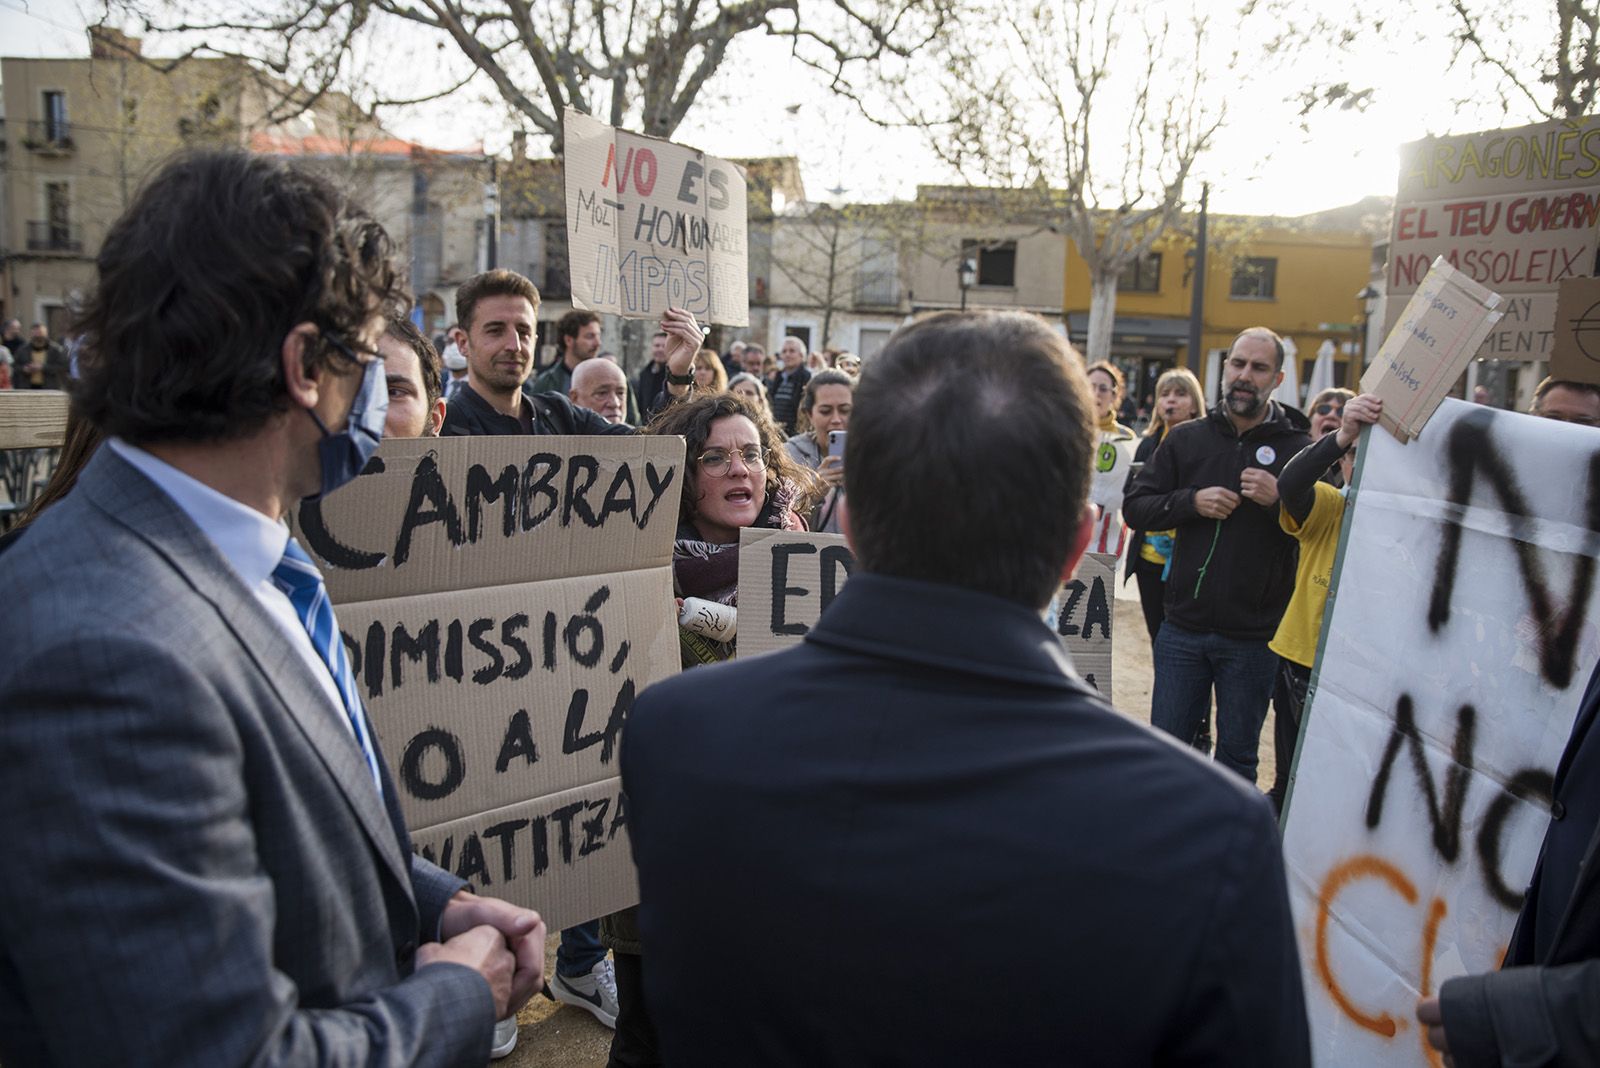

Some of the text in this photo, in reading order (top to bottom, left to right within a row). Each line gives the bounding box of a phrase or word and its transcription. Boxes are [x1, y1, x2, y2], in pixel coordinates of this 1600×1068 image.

[601, 143, 659, 197] NO
[1398, 207, 1439, 241] EL
[1443, 201, 1502, 237] TEU
[1394, 254, 1430, 288] NO
[298, 449, 676, 570] CAMBRAY
[495, 708, 540, 774] A
